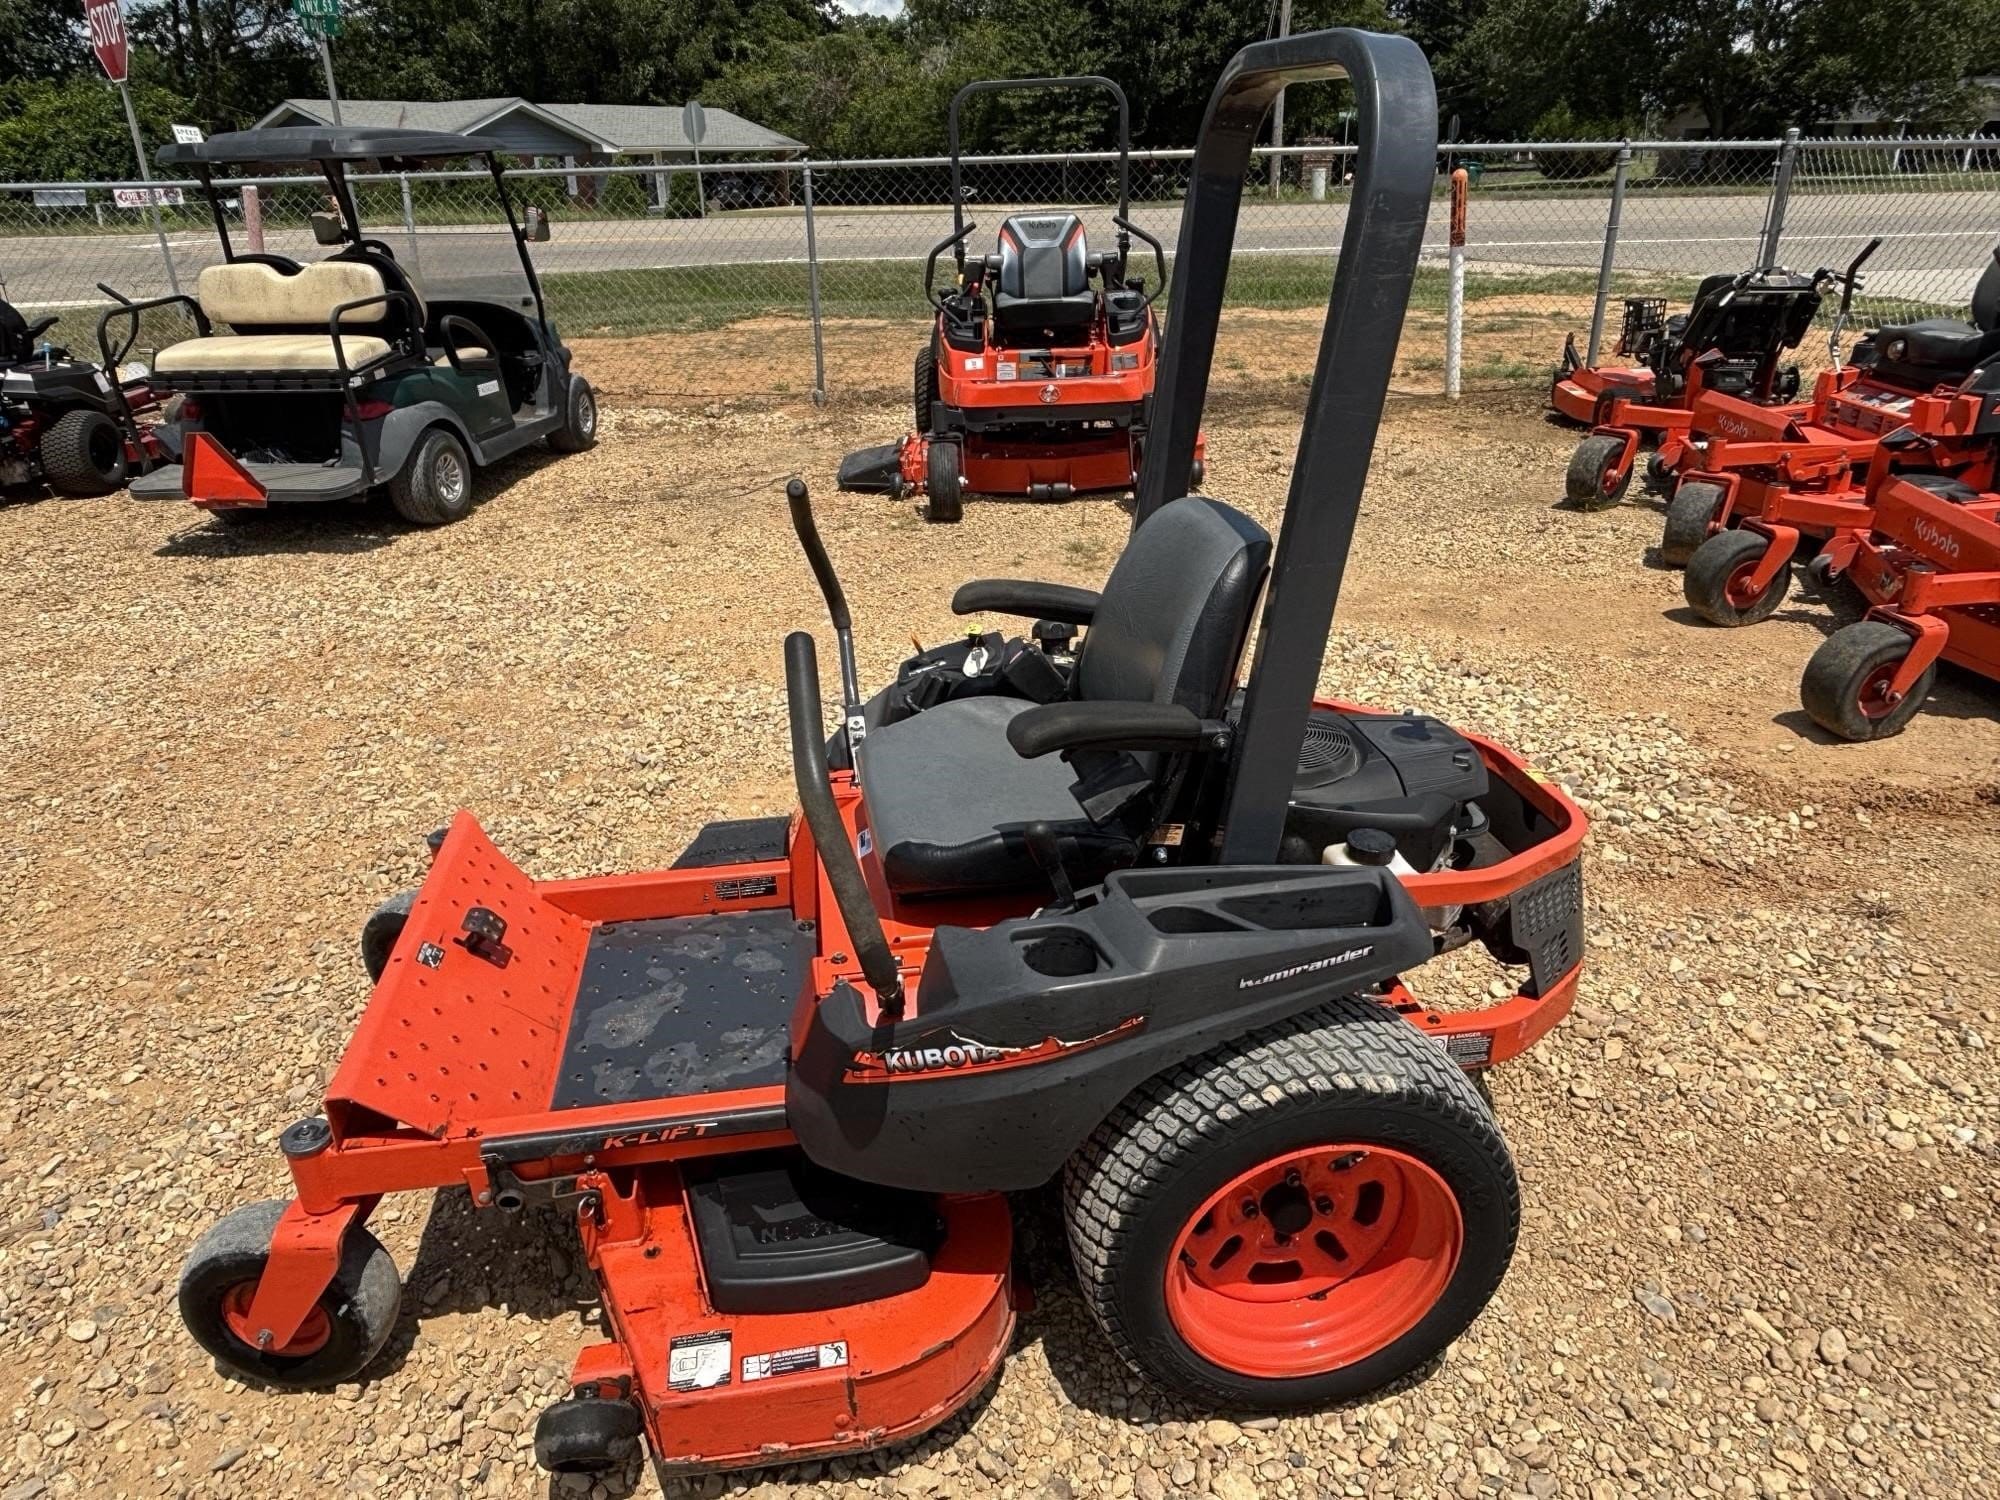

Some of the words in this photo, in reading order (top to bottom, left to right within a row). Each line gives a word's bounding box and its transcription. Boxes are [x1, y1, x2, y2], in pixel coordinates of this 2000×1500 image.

[90, 2, 121, 48] STOP
[122, 191, 138, 201] FOR
[1914, 516, 1960, 558] Kubota
[603, 1122, 718, 1150] K-LIFT
[781, 1345, 817, 1356] DANGER
